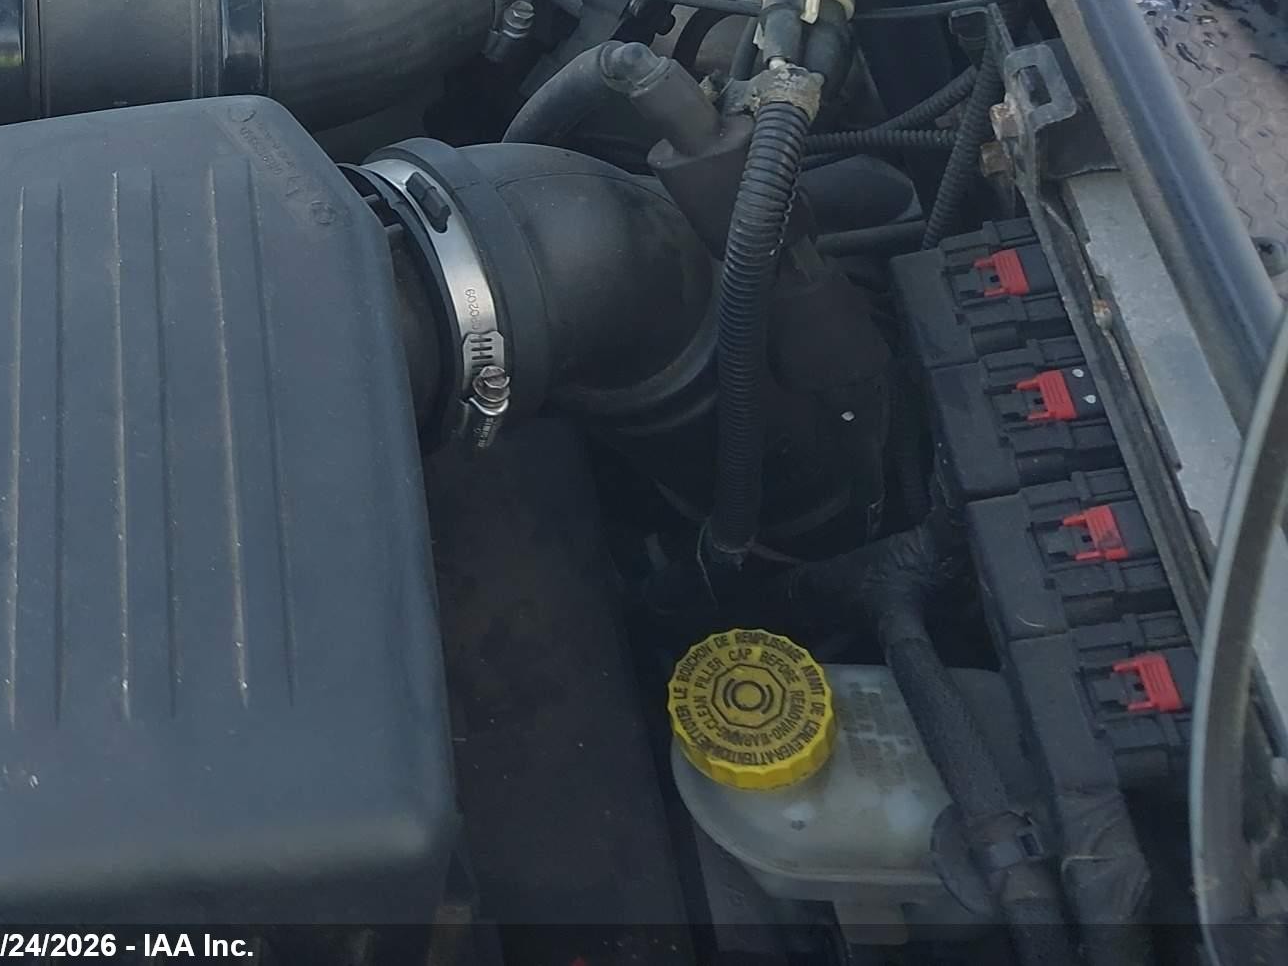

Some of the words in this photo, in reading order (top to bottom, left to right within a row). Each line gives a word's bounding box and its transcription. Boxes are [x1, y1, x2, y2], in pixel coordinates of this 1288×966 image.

[713, 635, 730, 648] DE
[728, 647, 752, 662] CAP
[677, 641, 713, 684] BOUCHON
[673, 685, 688, 700] LE
[810, 702, 827, 716] DE
